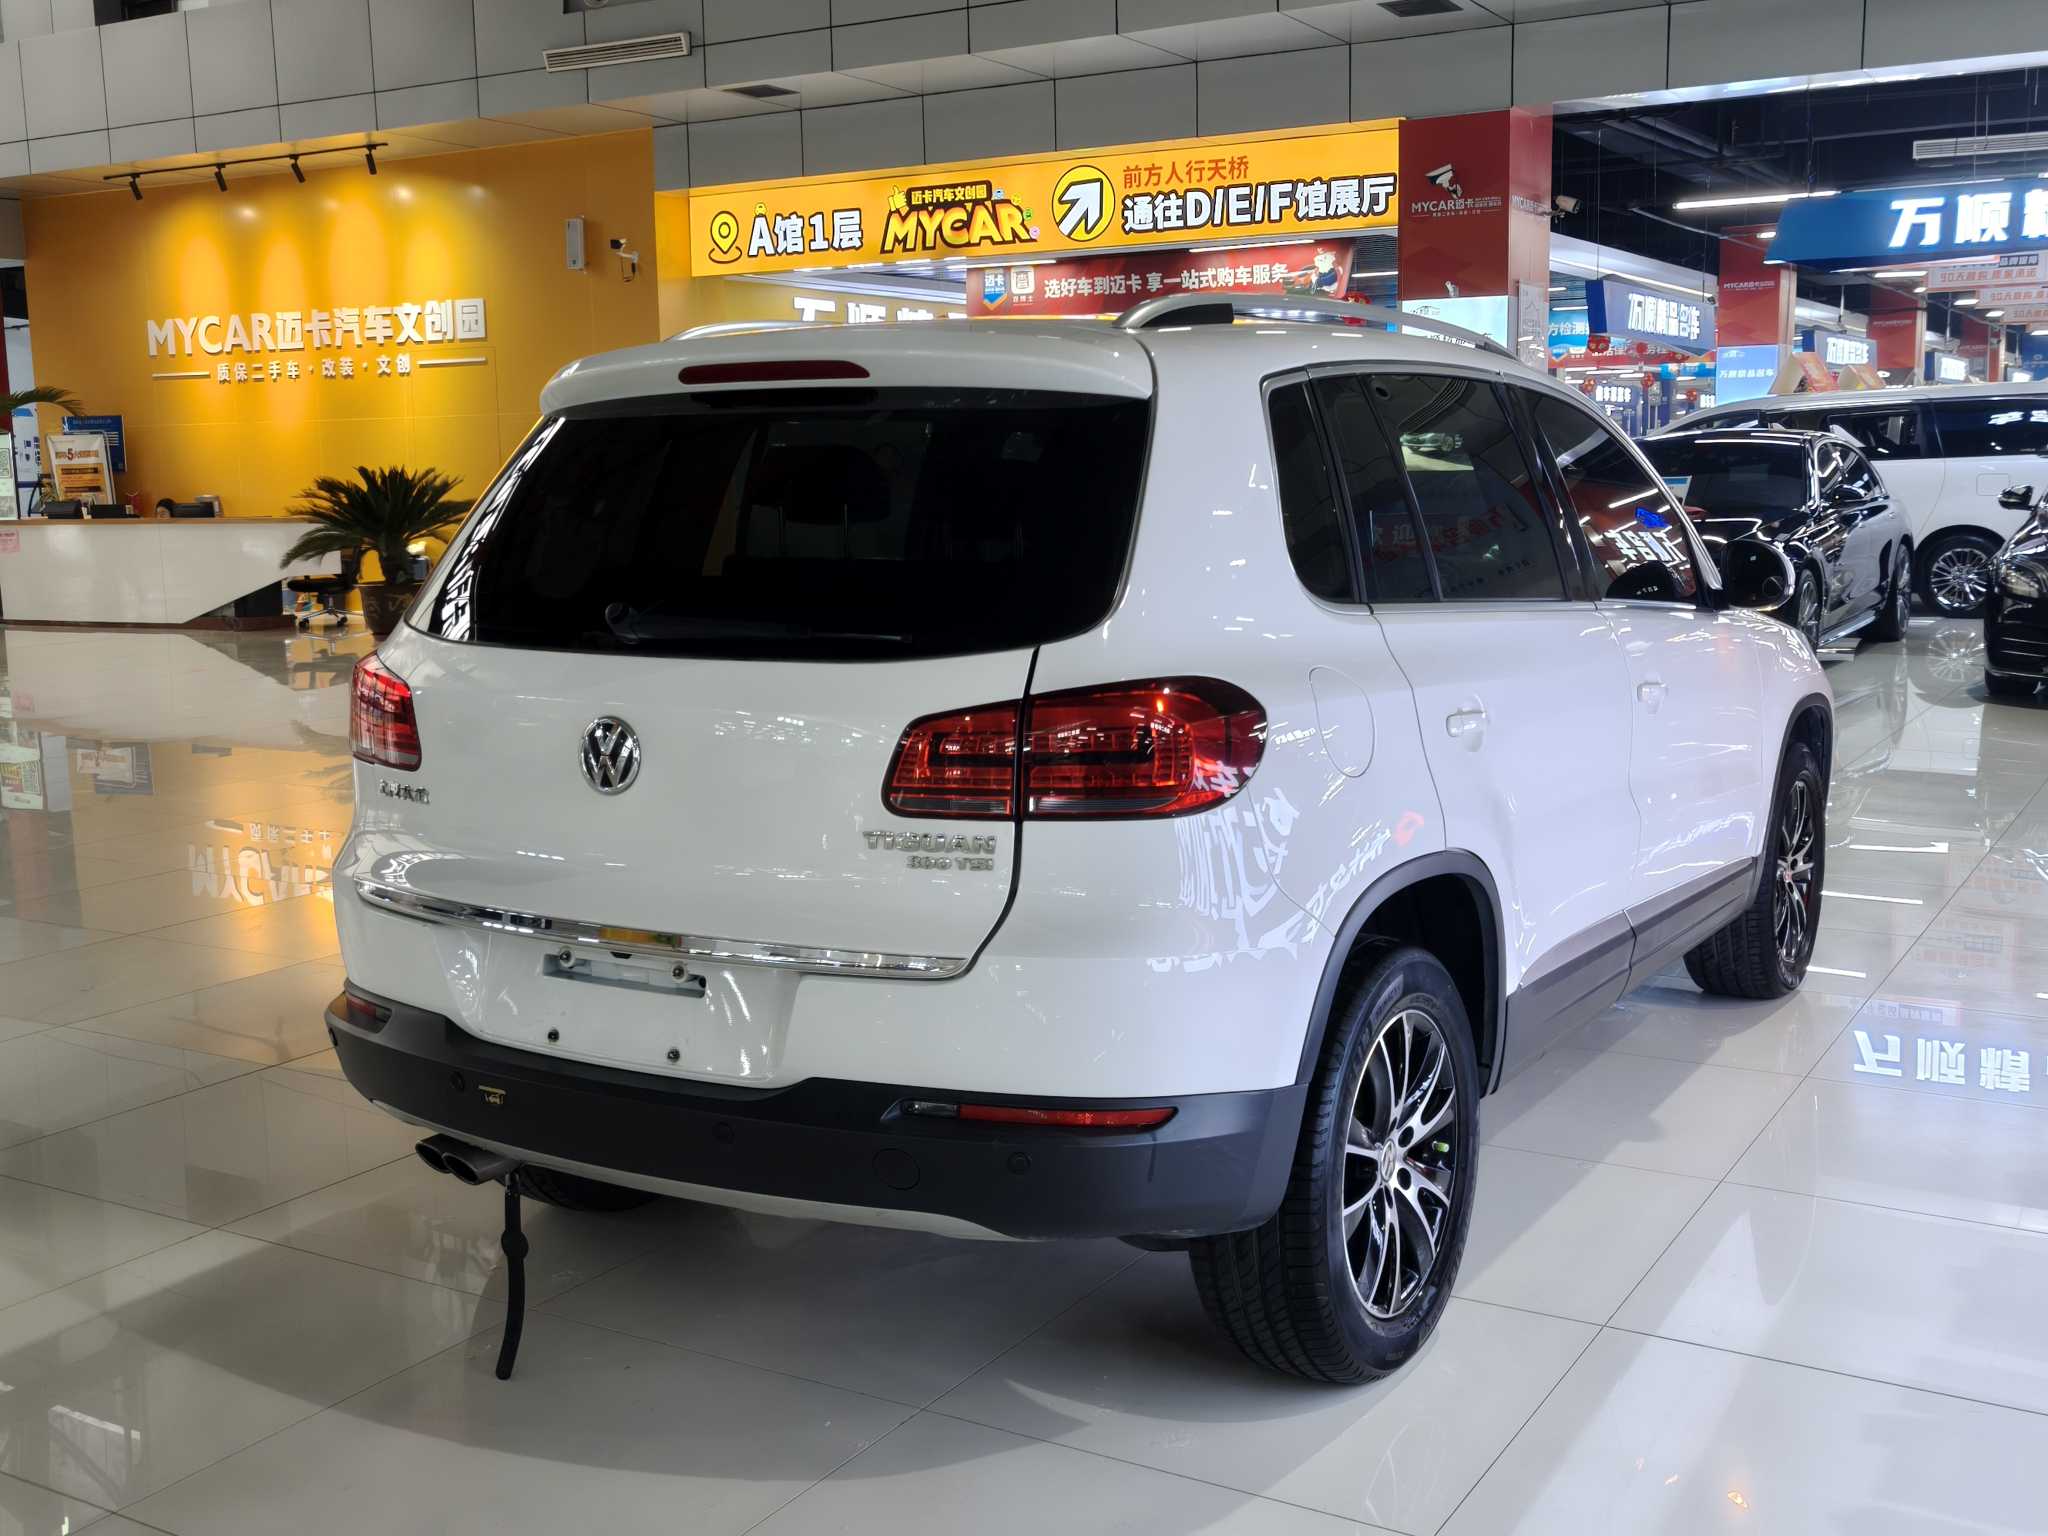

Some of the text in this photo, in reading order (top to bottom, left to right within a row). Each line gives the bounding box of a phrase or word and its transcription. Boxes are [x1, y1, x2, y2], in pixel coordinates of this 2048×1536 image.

[1123, 156, 1249, 189] 前方人行天桥
[912, 183, 987, 206] 迈卡汽车文创园
[1123, 175, 1396, 232] 通往D/E/F馆展厅
[748, 207, 864, 257] A馆1层
[880, 200, 1036, 253] MYCAR
[1044, 273, 1142, 298] 选好车到迈卡
[1146, 263, 1289, 292] 享一站式购车服务
[147, 298, 486, 357] MYCAR迈卡汽车文创园
[863, 830, 997, 855] TIGUAN
[906, 855, 994, 871] 300 TSI
